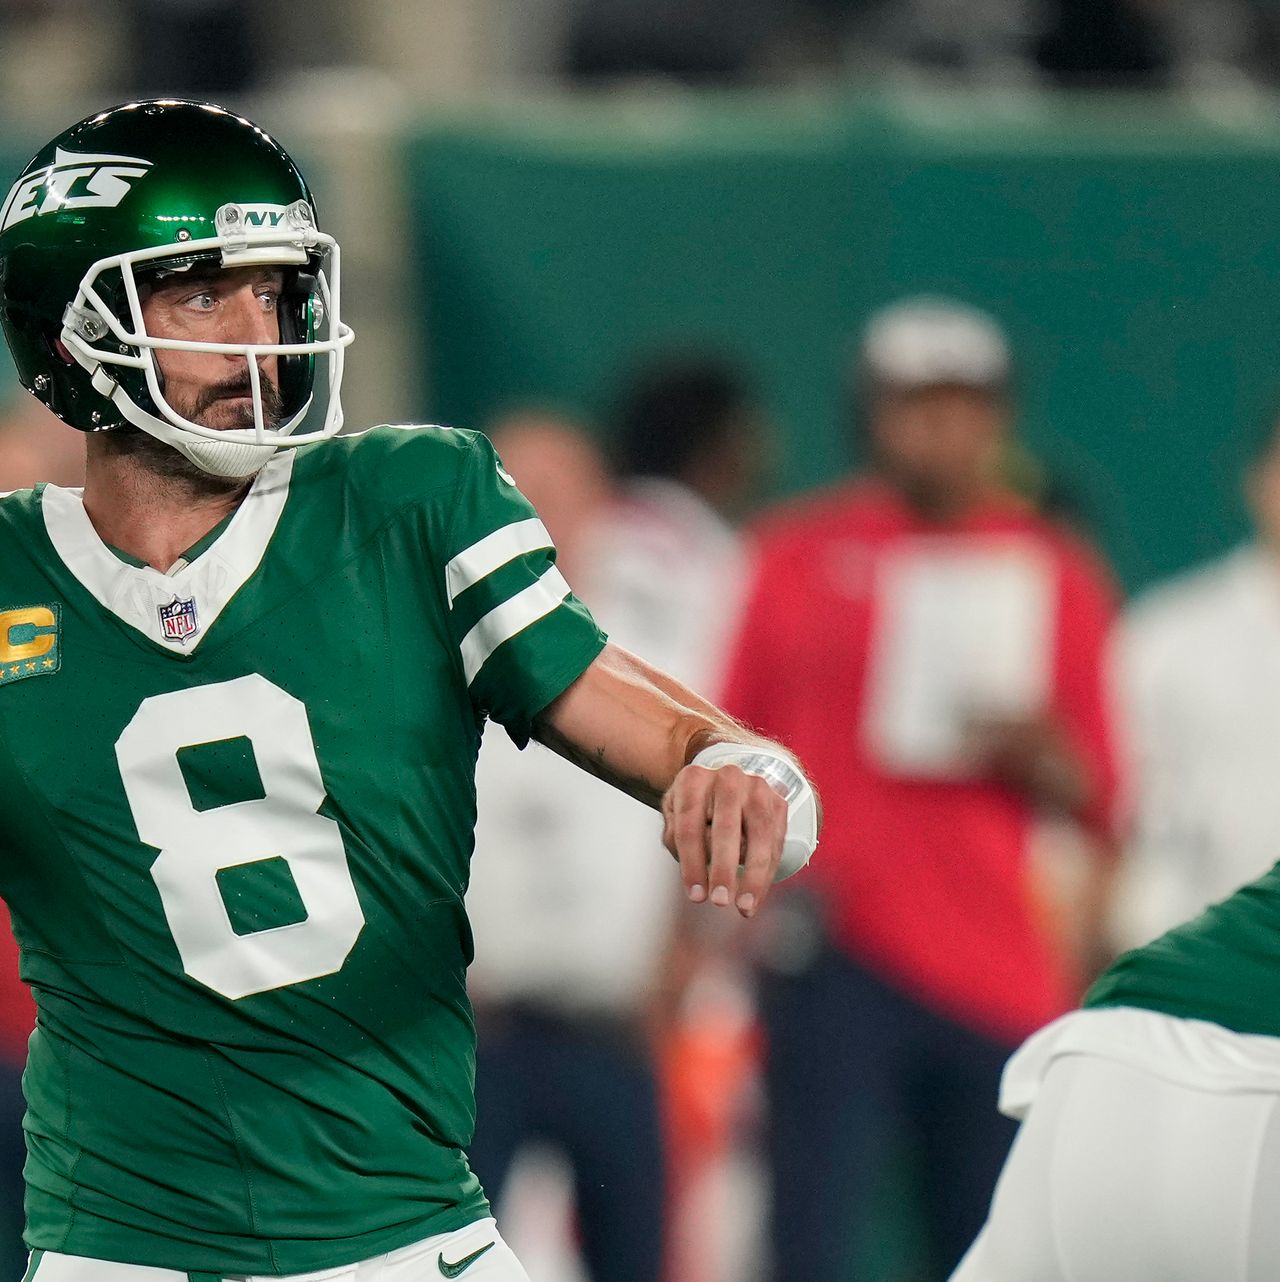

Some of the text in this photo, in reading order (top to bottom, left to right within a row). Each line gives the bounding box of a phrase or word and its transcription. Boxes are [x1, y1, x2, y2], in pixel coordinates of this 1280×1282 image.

[244, 211, 285, 226] NY
[165, 614, 194, 636] NFL
[114, 672, 366, 1001] 8
